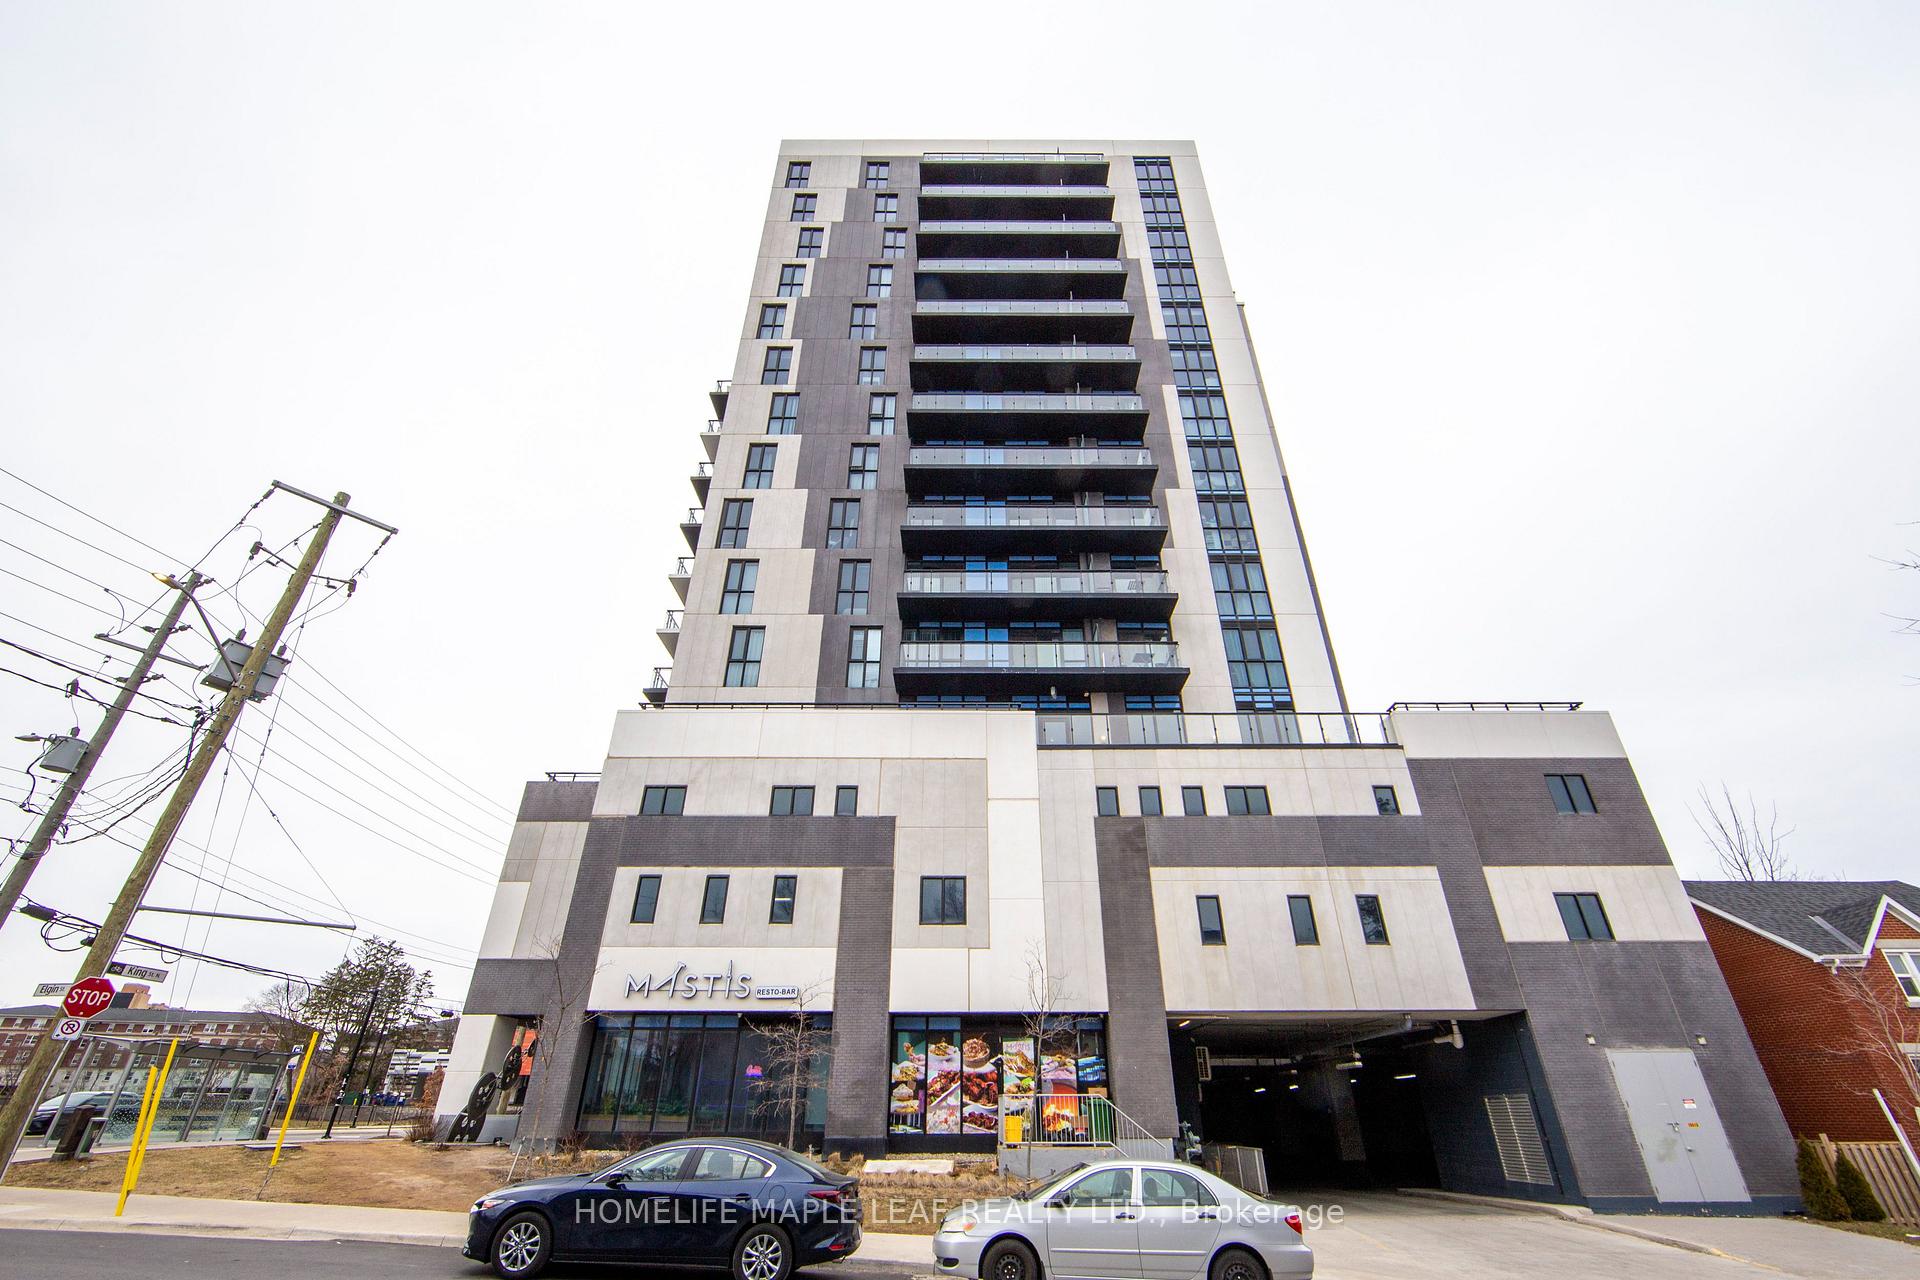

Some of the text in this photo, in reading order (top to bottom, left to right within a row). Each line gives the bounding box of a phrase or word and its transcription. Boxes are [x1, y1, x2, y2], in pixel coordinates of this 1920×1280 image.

[127, 966, 148, 979] King
[624, 960, 797, 999] MASTIS RESTO-BAR
[39, 985, 60, 996] Elgin
[67, 988, 111, 1006] STOP
